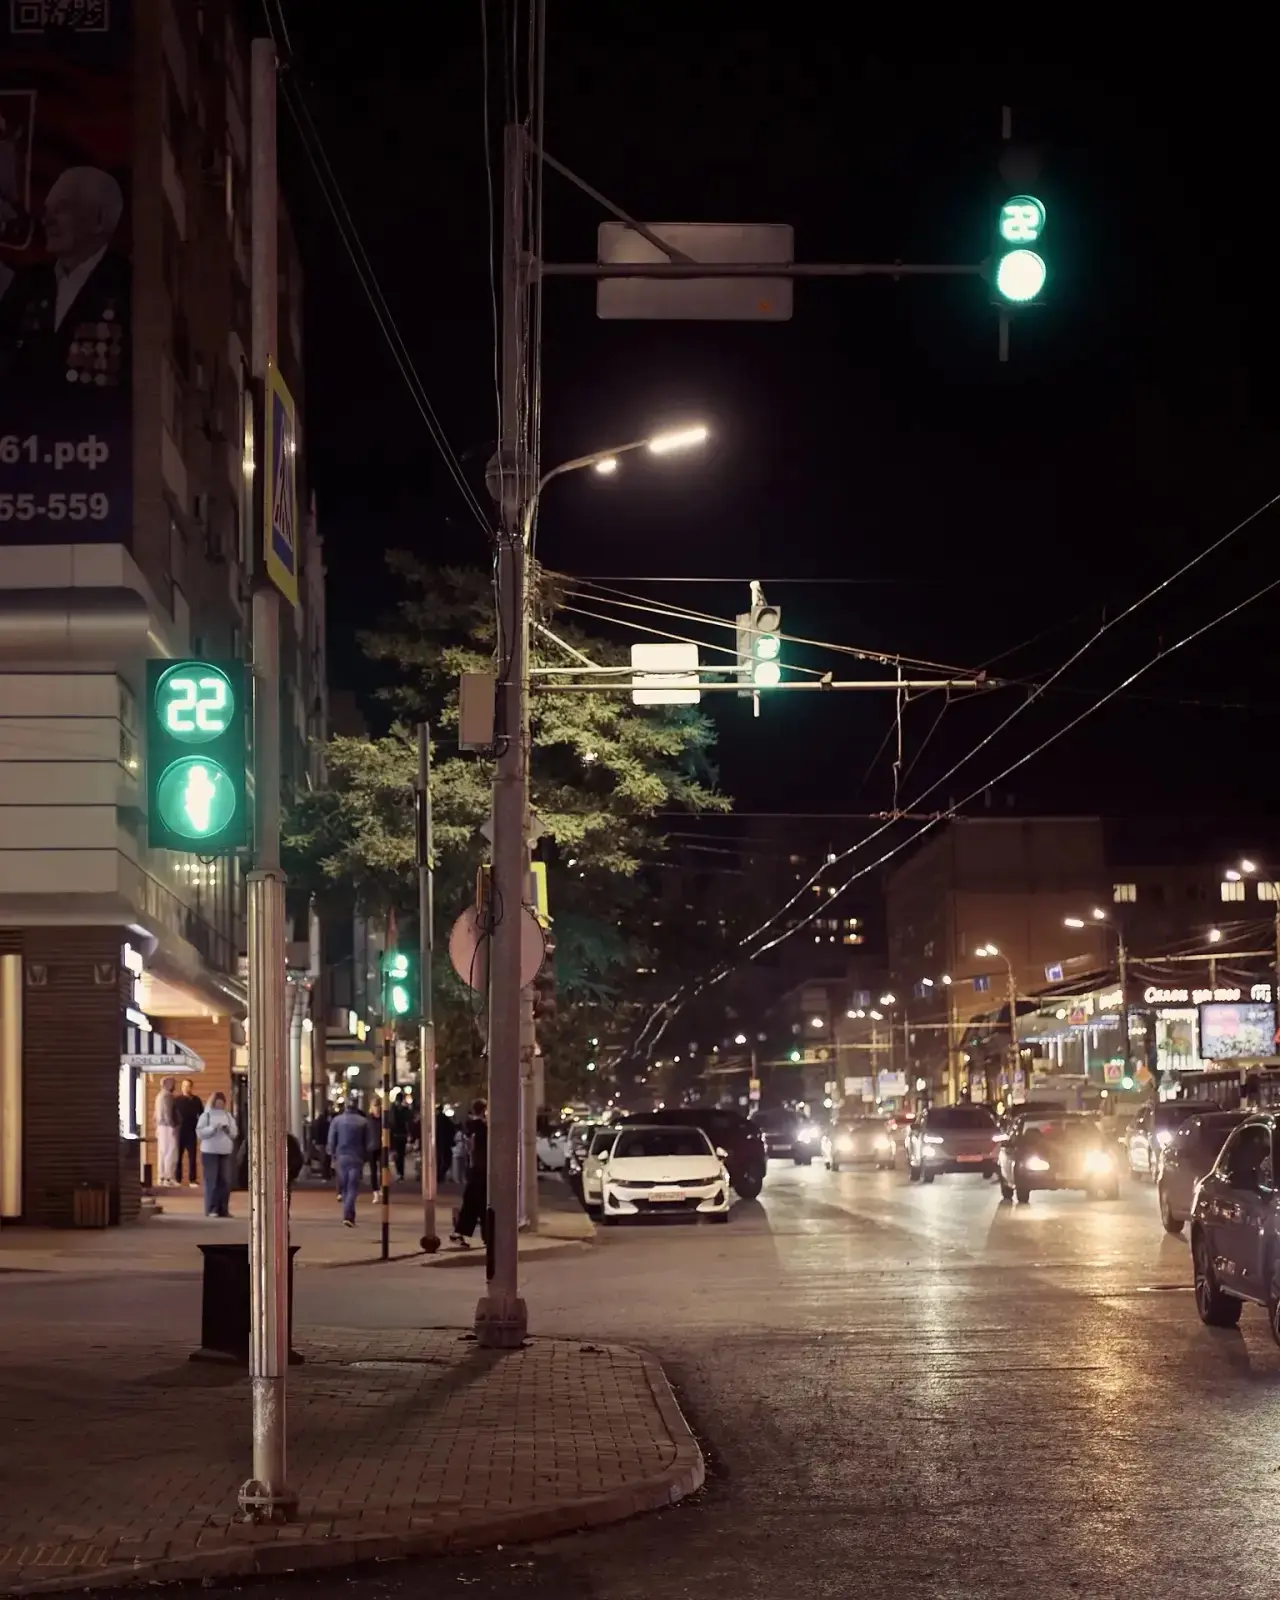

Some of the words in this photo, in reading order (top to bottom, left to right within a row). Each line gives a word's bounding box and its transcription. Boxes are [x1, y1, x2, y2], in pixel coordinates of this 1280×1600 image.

[0, 435, 108, 470] 61.рф
[0, 493, 109, 520] 55-559
[167, 678, 226, 731] 22
